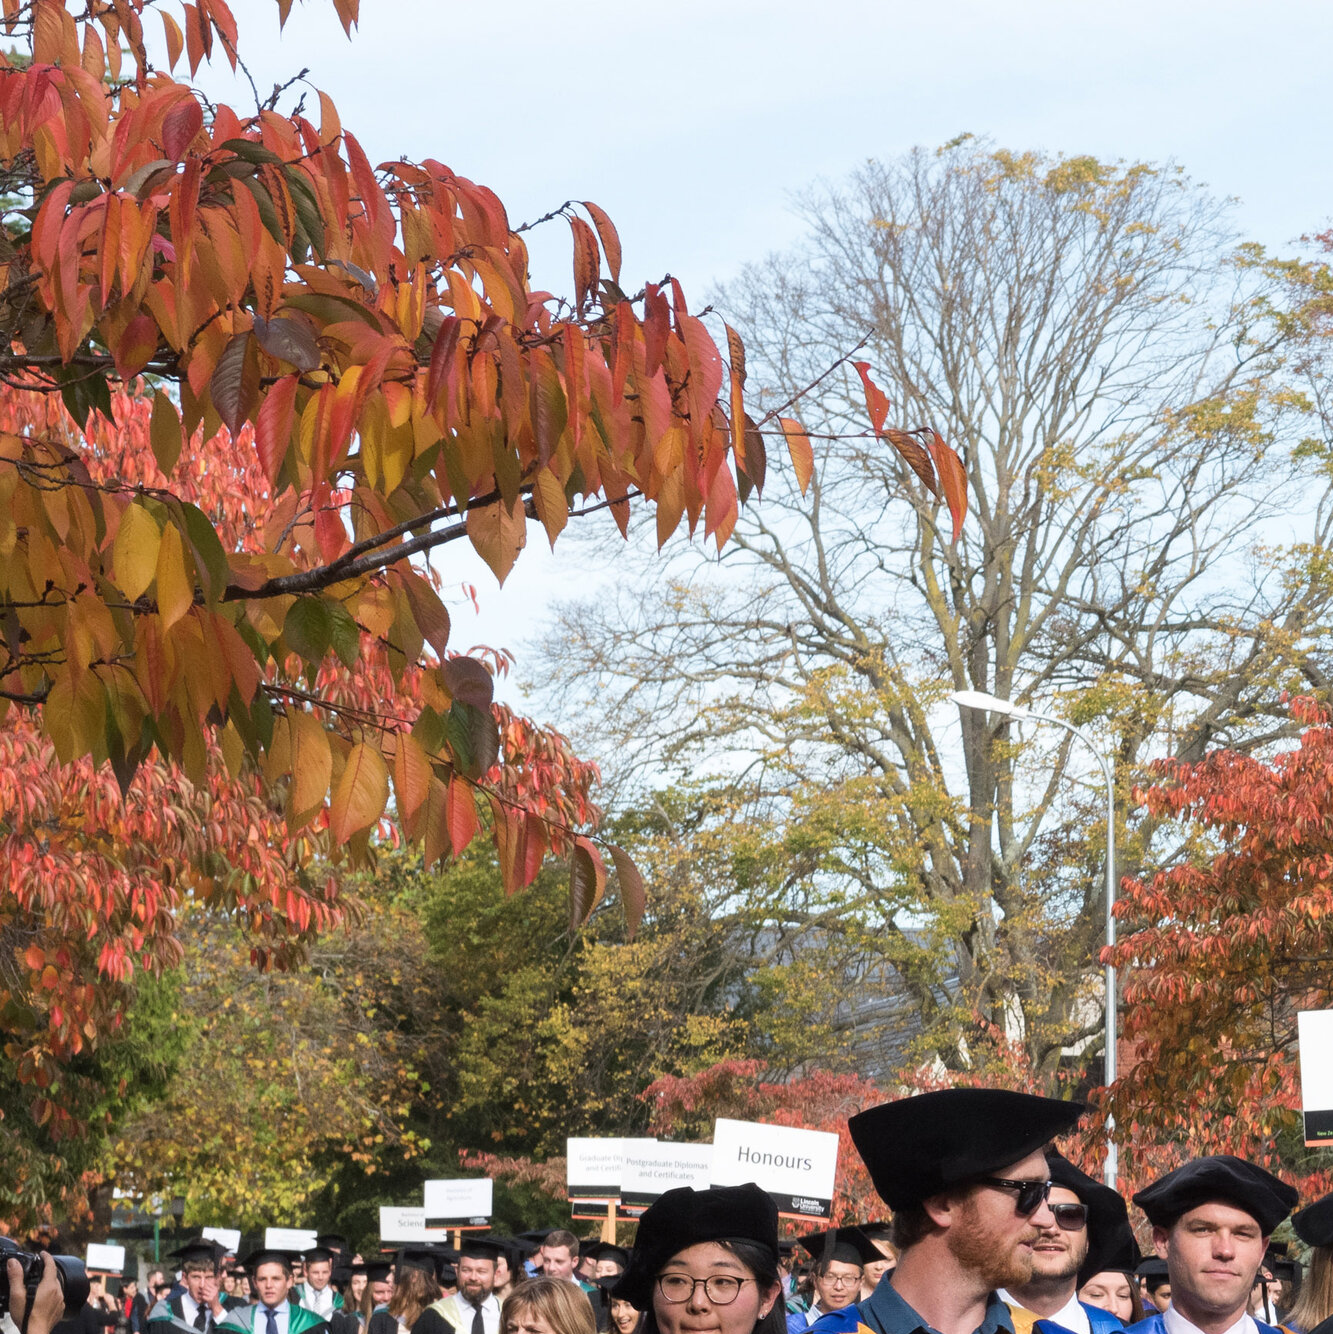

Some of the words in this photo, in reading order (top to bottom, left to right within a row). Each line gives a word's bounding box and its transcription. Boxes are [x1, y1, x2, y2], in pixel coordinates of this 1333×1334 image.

[626, 1157, 672, 1169] Postgraduate
[674, 1159, 709, 1171] Diplomas
[738, 1146, 812, 1171] Honours
[638, 1170, 653, 1178] and
[653, 1170, 695, 1181] Certificates
[398, 1219, 424, 1229] Scienc
